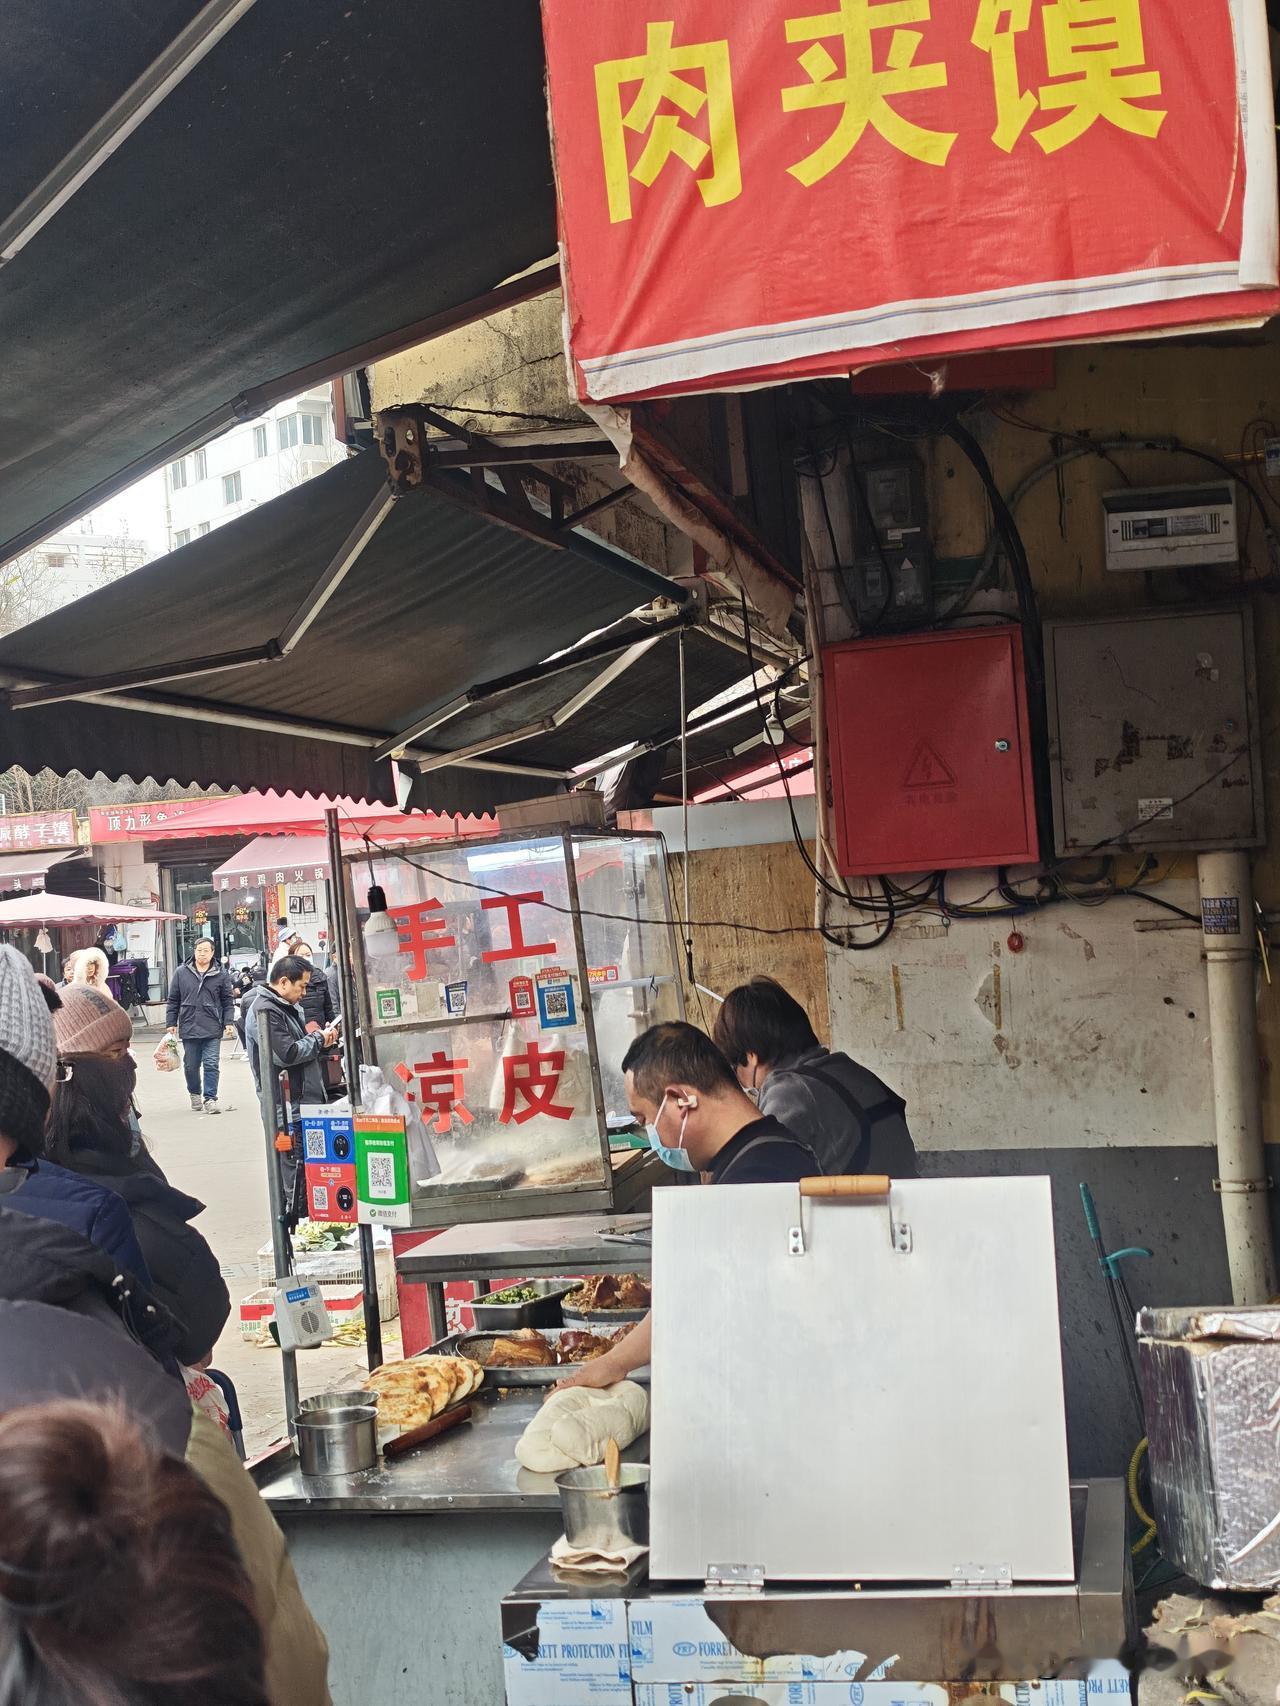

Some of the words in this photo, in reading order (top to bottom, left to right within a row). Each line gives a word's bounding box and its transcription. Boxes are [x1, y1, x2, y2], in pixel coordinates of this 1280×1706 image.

[593, 0, 1168, 224] 肉夹馍
[387, 891, 556, 980] 手工
[393, 1041, 575, 1133] 凉皮
[537, 1644, 557, 1659] RETT
[561, 1643, 615, 1659] PROTECTION
[631, 1620, 653, 1635] FILM
